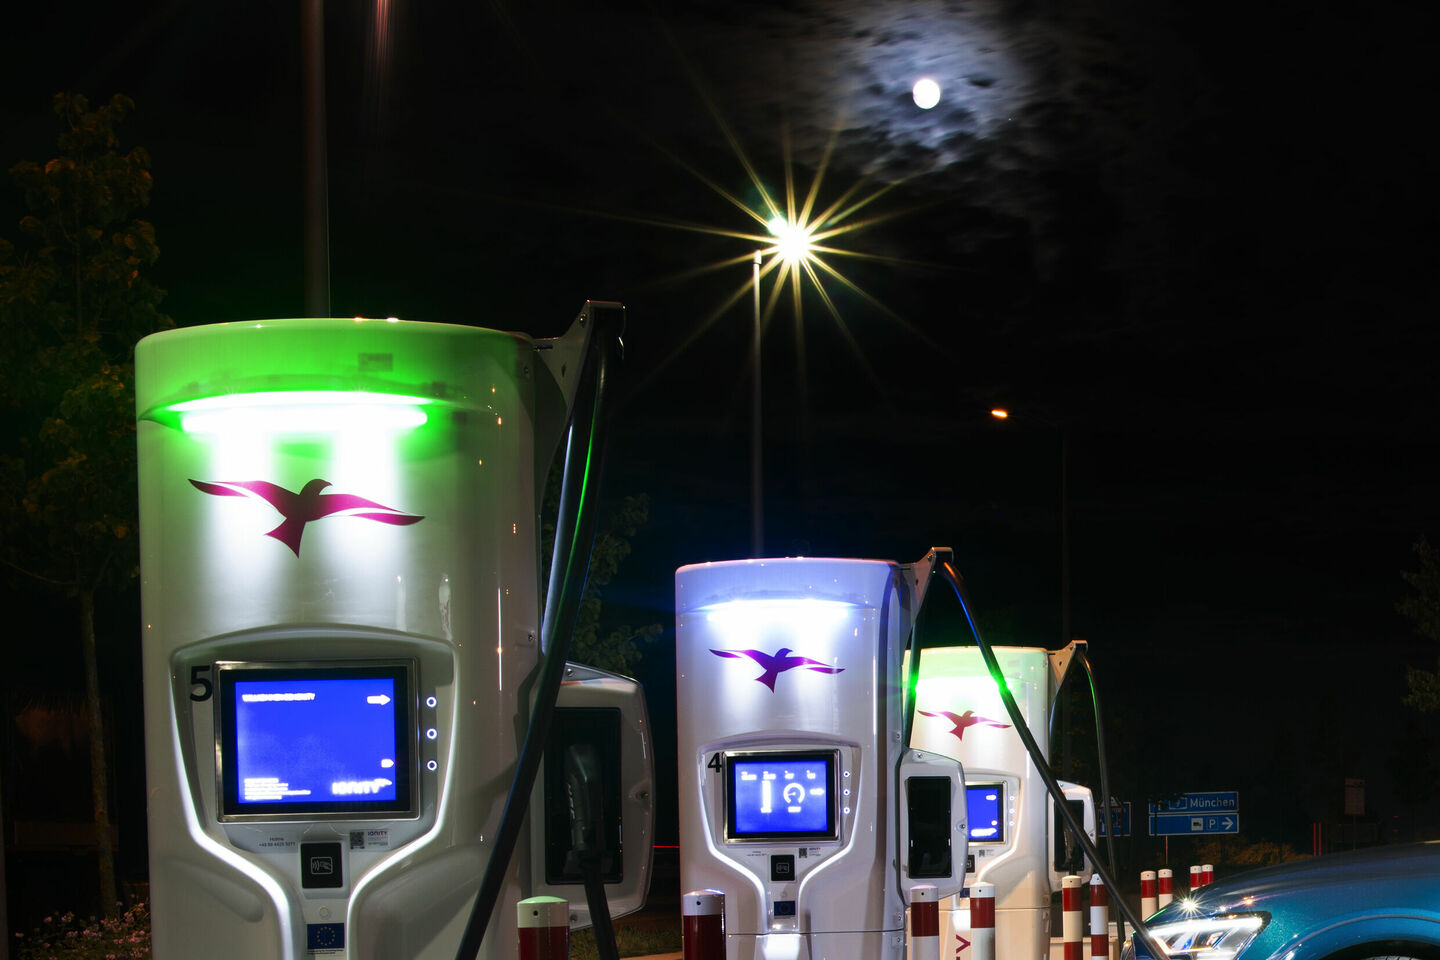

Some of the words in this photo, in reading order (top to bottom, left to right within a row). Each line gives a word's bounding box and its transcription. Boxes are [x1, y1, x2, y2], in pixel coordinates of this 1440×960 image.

[190, 665, 213, 702] 5
[707, 752, 722, 773] 4
[1190, 797, 1235, 808] München
